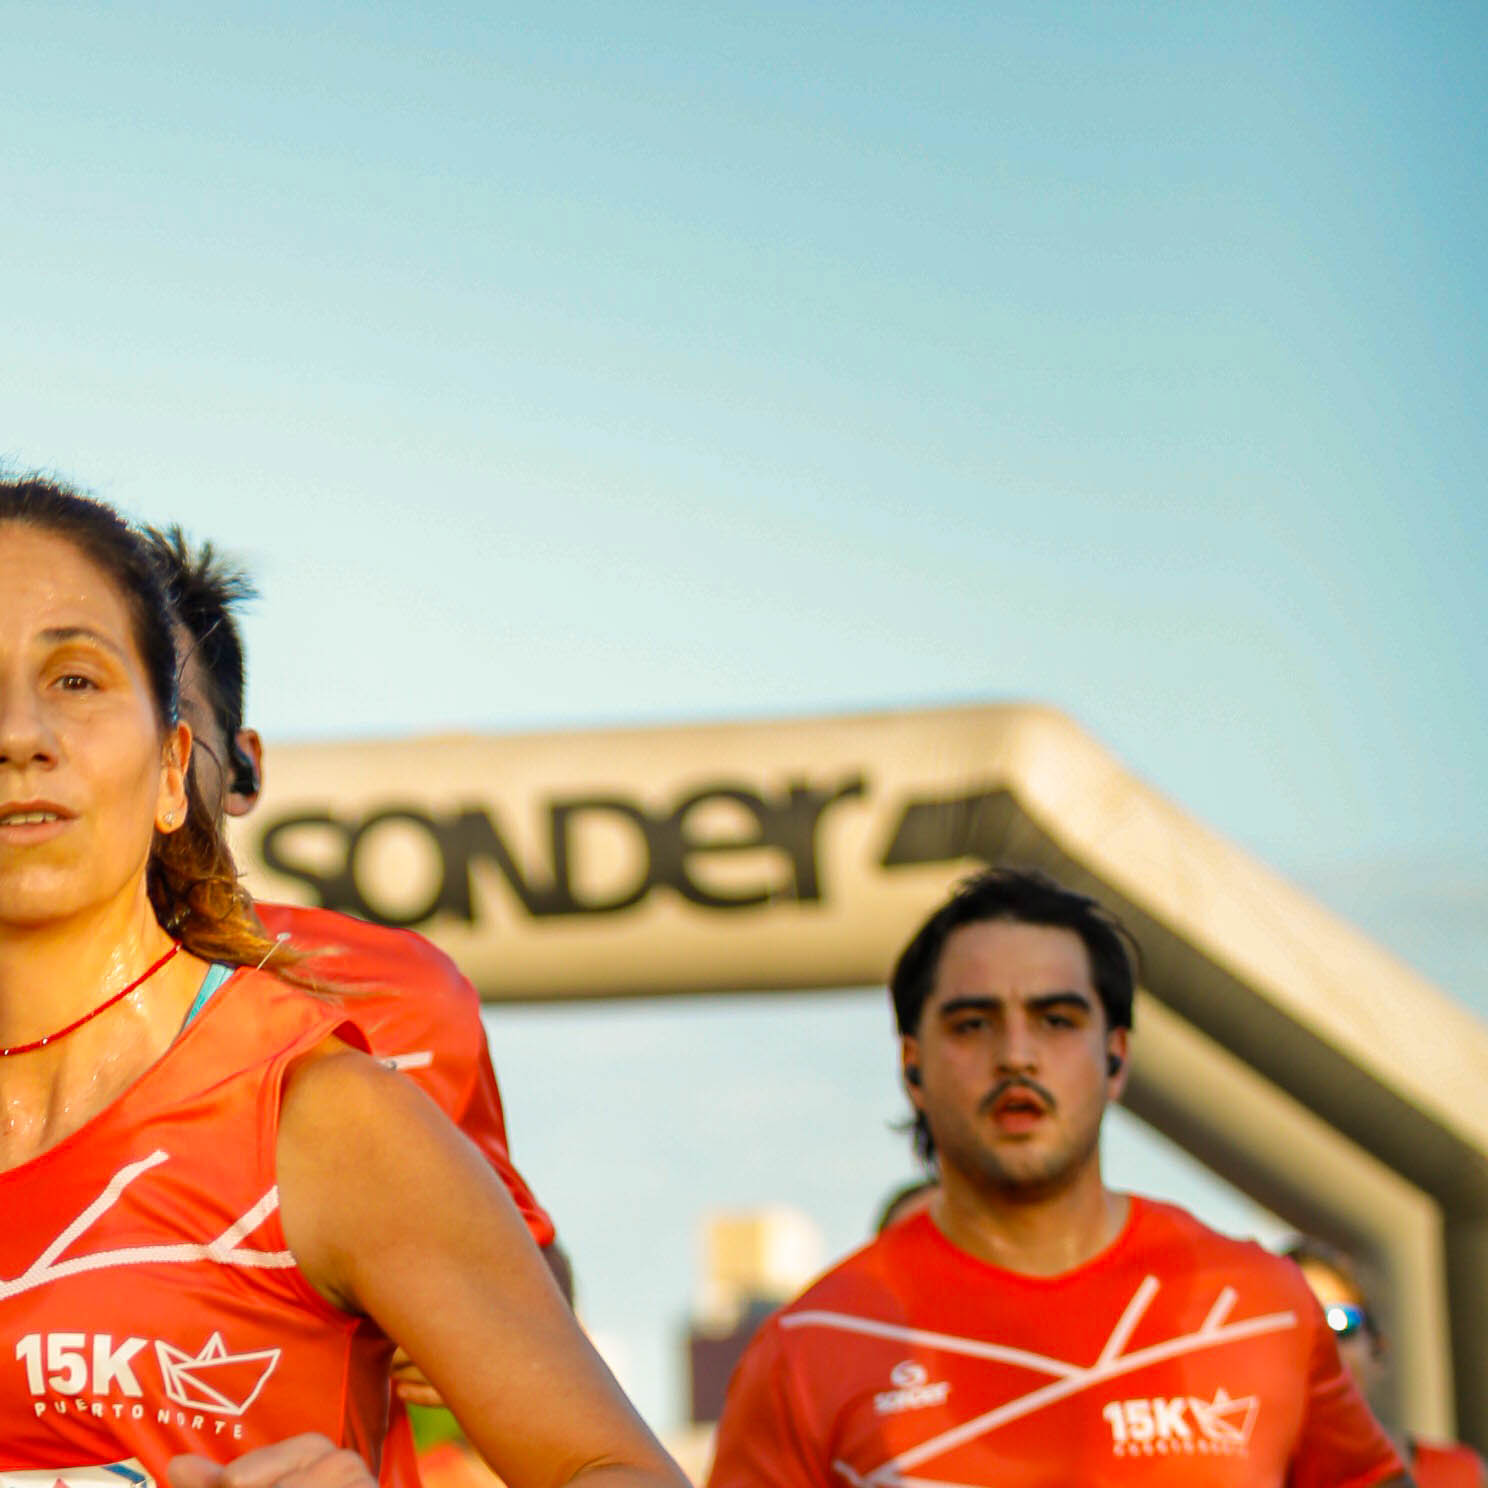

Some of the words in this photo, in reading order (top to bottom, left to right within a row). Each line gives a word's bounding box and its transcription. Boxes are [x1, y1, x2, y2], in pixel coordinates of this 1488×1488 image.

[15, 1332, 149, 1398] 15K
[33, 1398, 144, 1419] PUERTO
[157, 1408, 243, 1440] NORTE
[1102, 1397, 1188, 1441] 15K
